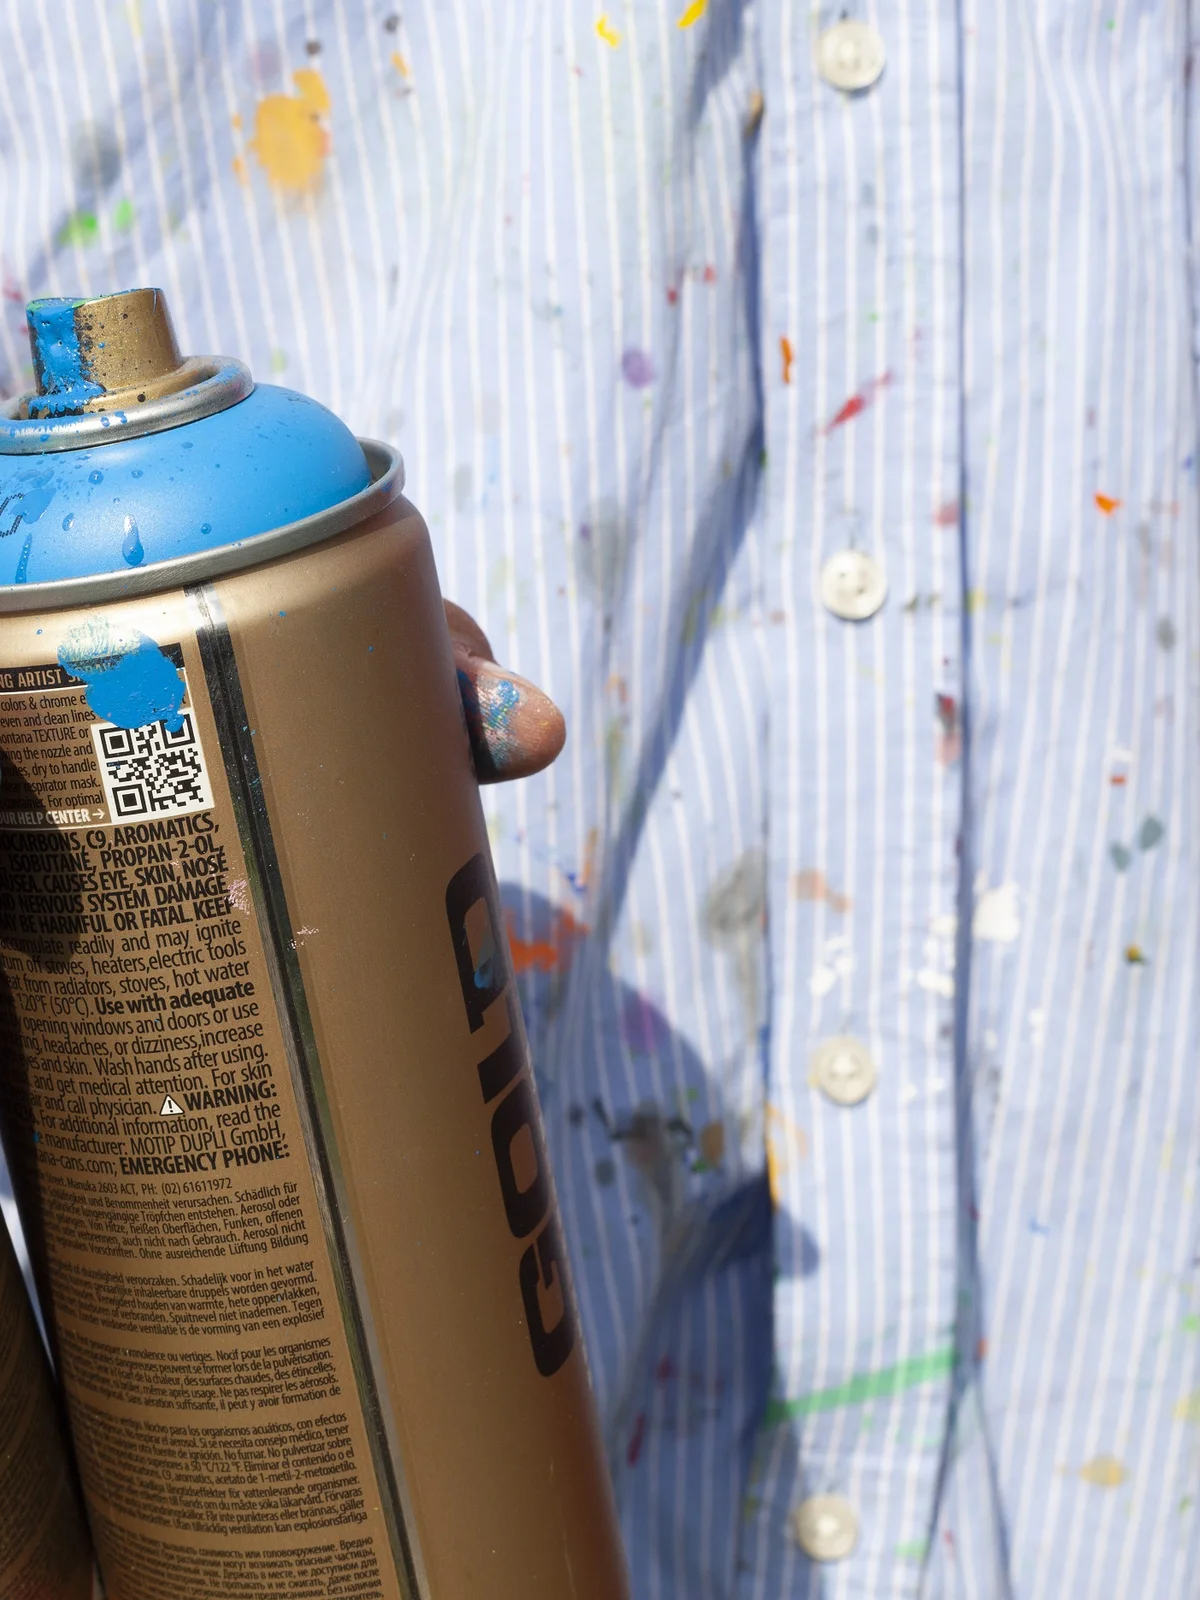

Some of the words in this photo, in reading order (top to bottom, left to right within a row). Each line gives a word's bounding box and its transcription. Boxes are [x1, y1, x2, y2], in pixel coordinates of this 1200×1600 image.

[18, 669, 62, 687] ARTIST
[1, 699, 26, 711] colors
[29, 696, 37, 709] &
[39, 695, 77, 709] chrome
[1, 717, 21, 727] even
[23, 713, 42, 726] and
[45, 712, 69, 725] clean
[71, 710, 96, 721] lines
[32, 726, 75, 742] TEXTURE
[80, 728, 88, 738] or
[24, 748, 37, 760] the
[38, 746, 72, 759] nozzle
[74, 742, 93, 756] and
[32, 763, 47, 779] dry
[50, 763, 59, 775] to
[61, 760, 97, 774] handle
[24, 778, 68, 794] respirator
[70, 775, 100, 790] mask.
[49, 795, 62, 807] For
[65, 791, 104, 809] optimal
[18, 812, 43, 825] HELP
[46, 809, 92, 825] CENTER
[86, 829, 112, 850] C9,
[115, 812, 219, 848] AROMATICS,
[100, 835, 225, 870] PROPAN-2-OL,
[44, 870, 99, 893] CAUSES
[100, 868, 135, 892] EYE,
[135, 862, 181, 888] SKIN,
[183, 852, 229, 878] NOSE
[22, 893, 85, 914] NERVOUS
[89, 887, 149, 913] SYSTEM
[155, 875, 227, 906] DAMAGE
[21, 914, 37, 933] BE
[40, 909, 109, 934] HARMFUL
[114, 909, 139, 931] OR
[142, 904, 193, 928] FATAL.
[195, 896, 234, 922] KEEP
[69, 934, 114, 958] readily
[121, 931, 149, 951] and
[155, 930, 189, 953] may
[196, 918, 242, 946] ignite
[27, 955, 42, 974] off
[45, 960, 89, 977] stoves,
[208, 939, 247, 961] tools
[23, 974, 52, 994] from
[55, 977, 116, 997] radiators,
[119, 972, 170, 994] stoves,
[174, 967, 201, 989] hot
[204, 960, 250, 984] water
[96, 999, 125, 1016] Use
[127, 993, 168, 1013] with
[169, 981, 255, 1011] adequate
[23, 1015, 70, 1039] opening
[72, 1015, 134, 1036] windows
[137, 1013, 165, 1034] and
[167, 1009, 211, 1030] doors
[213, 1007, 229, 1026] or
[232, 1001, 259, 1020] use
[41, 1055, 62, 1071] and
[63, 1057, 92, 1075] skin.
[93, 1056, 133, 1076] Wash
[135, 1053, 182, 1076] hands
[183, 1049, 218, 1071] after
[222, 1042, 269, 1068] using.
[42, 1037, 112, 1058] headaches,
[114, 1038, 129, 1055] or
[34, 1073, 54, 1092] and
[57, 1078, 77, 1098] get
[80, 1077, 131, 1096] medical
[135, 1072, 208, 1097] attention.
[211, 1068, 236, 1087] For
[239, 1061, 273, 1083] skin
[45, 1095, 65, 1112] and
[67, 1095, 87, 1114] call
[91, 1097, 157, 1121] physician.
[183, 1080, 277, 1111] WARNING:
[40, 1109, 56, 1129] For
[59, 1114, 120, 1136] additional
[122, 1113, 214, 1136] information,
[217, 1107, 252, 1129] read
[253, 1101, 281, 1122] the
[45, 1133, 128, 1156] manufacturer:
[130, 1133, 176, 1156] MOTIP
[181, 1129, 226, 1153] DUPLI
[230, 1121, 286, 1147] GmbH,
[120, 1151, 219, 1176] EMERGENCY
[223, 1142, 290, 1168] PHONE:
[161, 1179, 181, 1196] (02)
[235, 1187, 281, 1204] Schädlich
[283, 1181, 298, 1196] für
[240, 1201, 277, 1217] Aerosol
[278, 1195, 300, 1210] oder
[265, 1208, 303, 1225] offenen
[229, 1241, 268, 1256] Lüftung
[271, 1233, 308, 1250] Bildung
[286, 1260, 314, 1275] water
